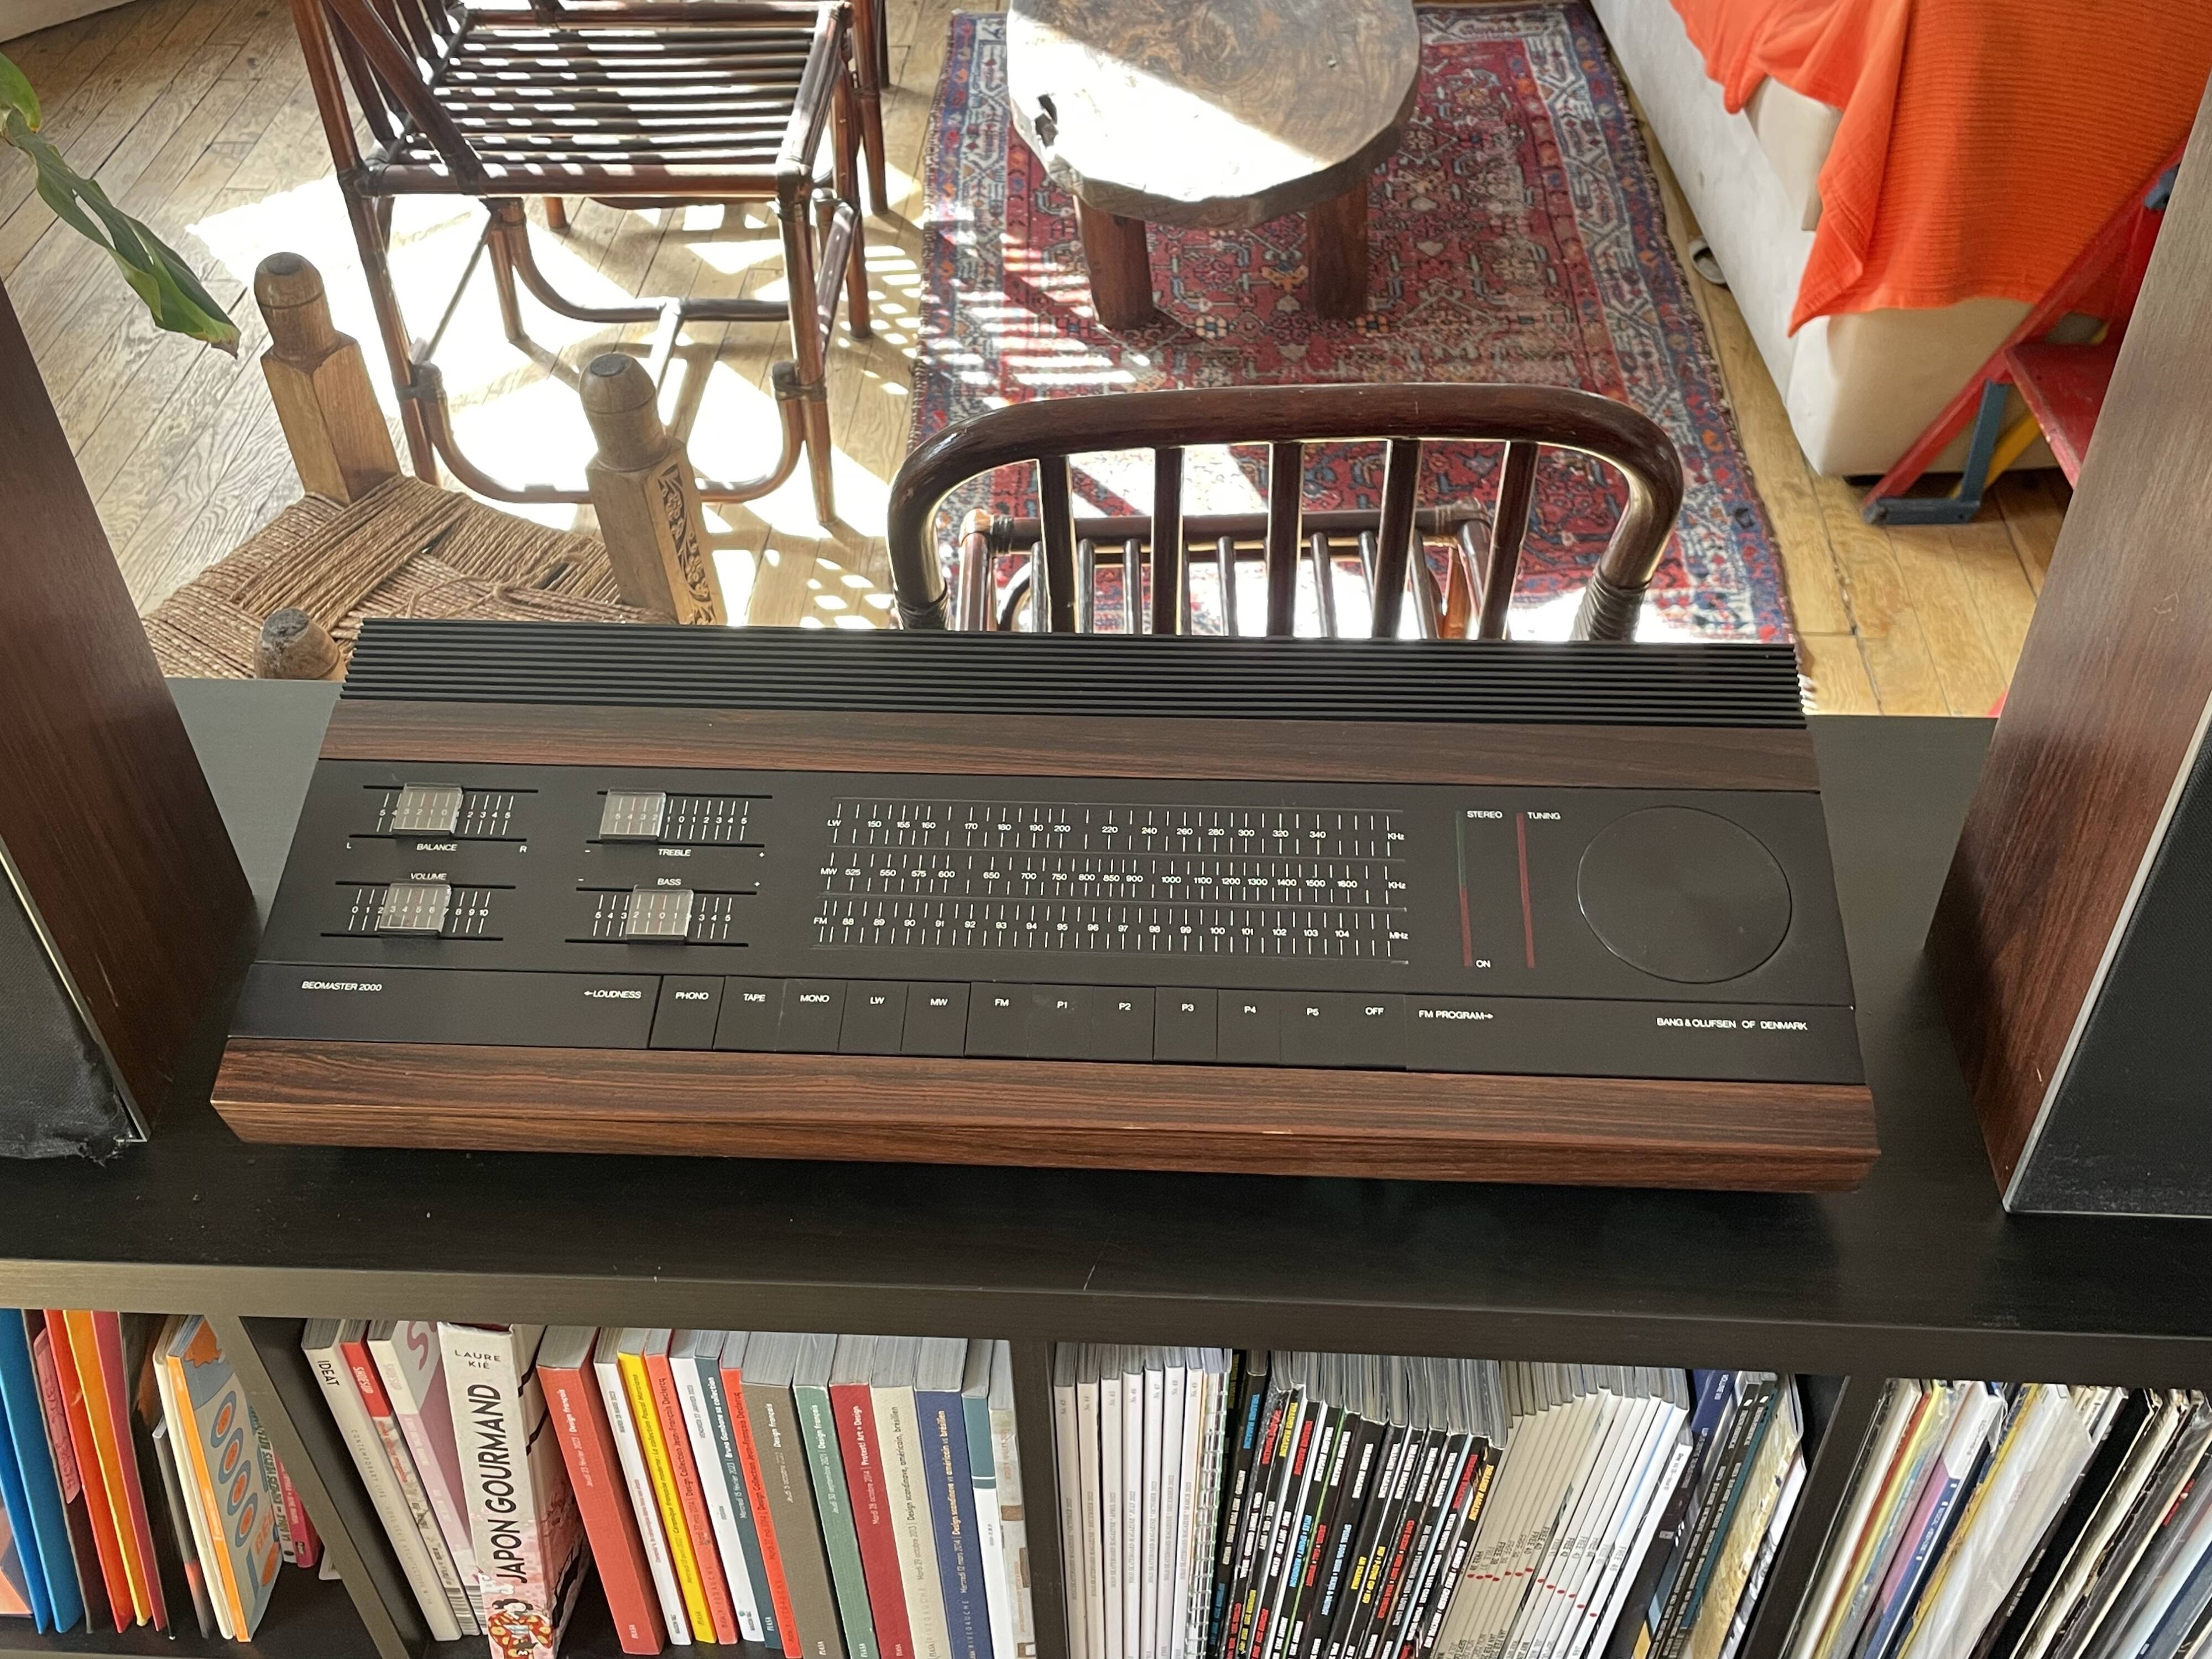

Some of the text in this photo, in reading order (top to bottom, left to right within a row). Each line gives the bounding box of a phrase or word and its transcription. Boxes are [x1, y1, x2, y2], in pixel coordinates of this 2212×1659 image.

[302, 982, 358, 990] BEOMASTER
[1436, 1010, 1484, 1019] PROGRAM
[1657, 1018, 1683, 1026] BANG
[1692, 1019, 1736, 1028] OLUFSEN
[1742, 1020, 1755, 1029] OF
[1760, 1021, 1807, 1030] DENMARK
[455, 1350, 501, 1362] LAURE
[468, 1360, 490, 1369] KIÉ
[317, 1361, 340, 1385] IDEAT
[659, 1378, 670, 1404] Declercq
[708, 1378, 720, 1405] collection
[557, 1390, 577, 1432] Design français
[853, 1406, 862, 1425] Design
[766, 1404, 781, 1447] Design français
[811, 1405, 826, 1448] Design français
[1280, 1402, 1298, 1457] THRASHER MAGAZINE
[639, 1402, 679, 1533] Céramique française collection Pascal
[676, 1448, 688, 1477] Collection
[1314, 1427, 1333, 1481] THRASHER MAGAZINE
[1331, 1432, 1350, 1486] THRASHER MAGAZINE
[468, 1385, 527, 1583] JAPON GOURMAND
[1395, 1444, 1418, 1499] THRASHER MAGAZINE
[684, 1478, 693, 1496] Design
[948, 1484, 957, 1515] scandinave
[907, 1503, 915, 1520] Design
[951, 1516, 961, 1535] Design
